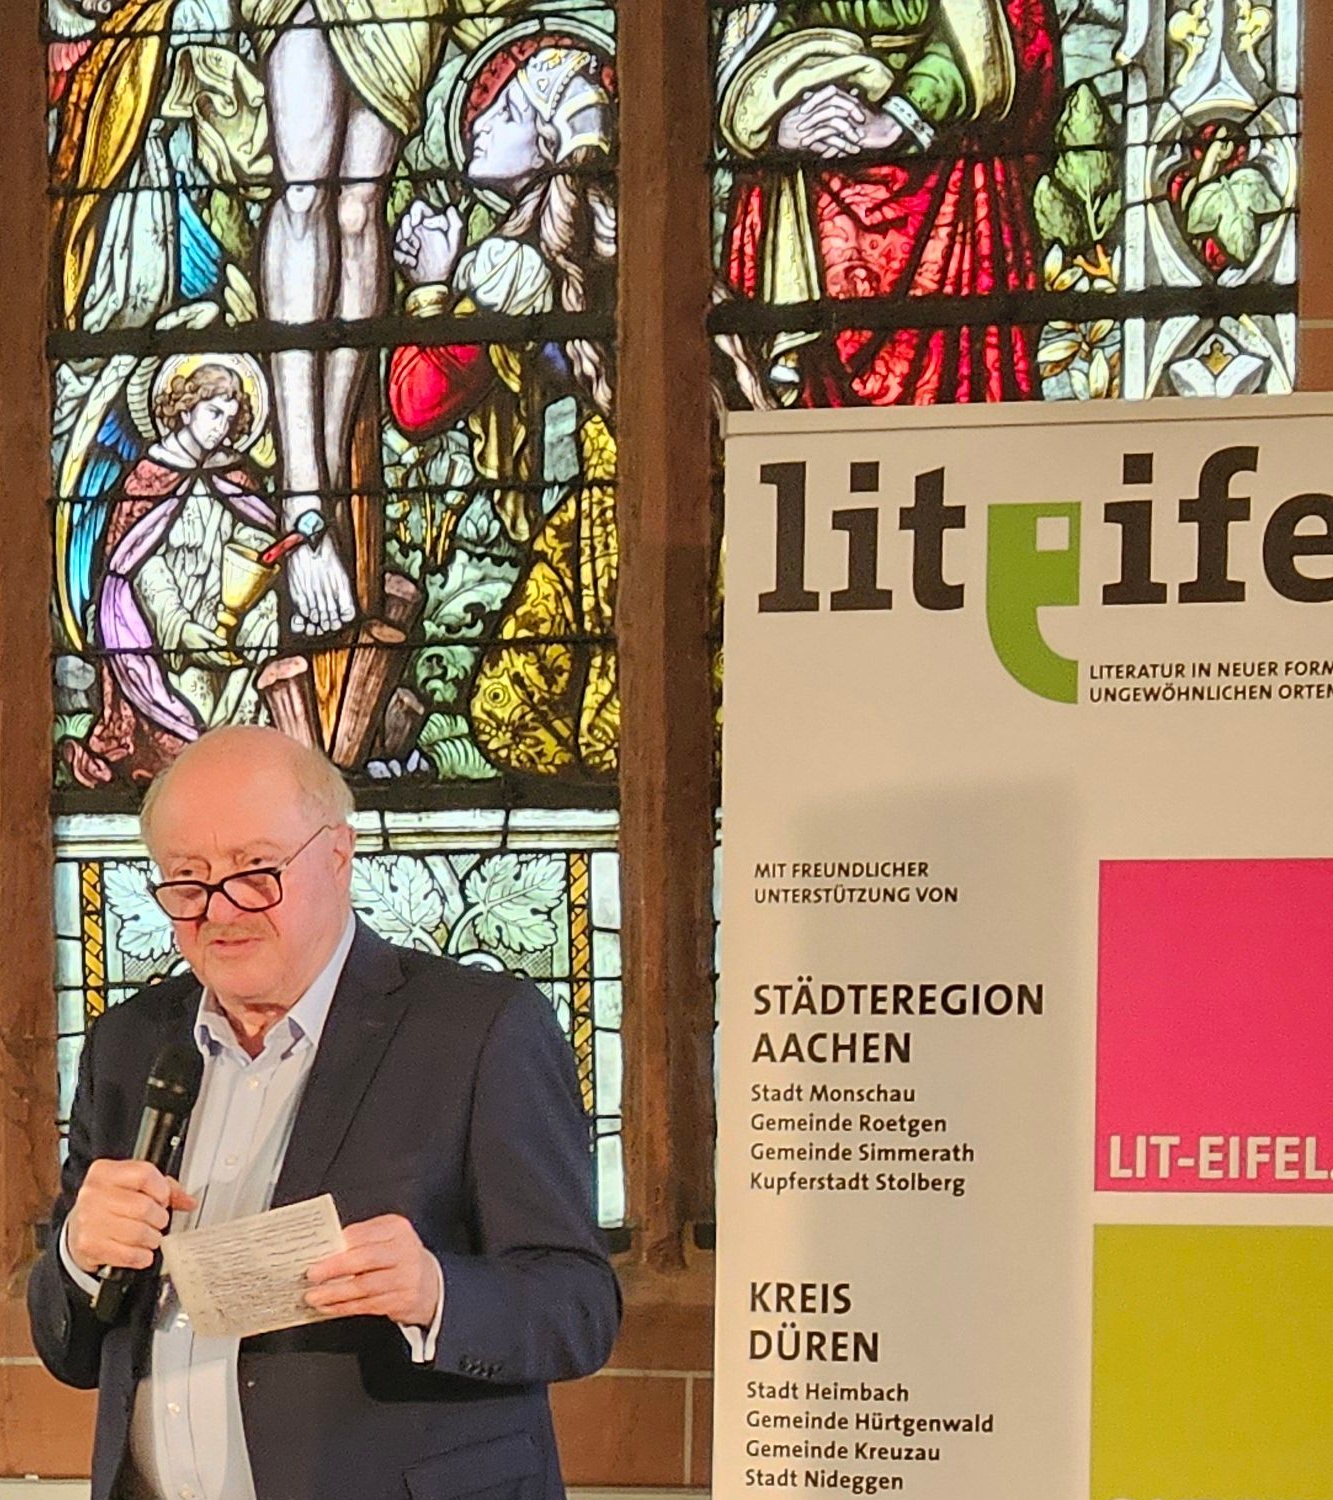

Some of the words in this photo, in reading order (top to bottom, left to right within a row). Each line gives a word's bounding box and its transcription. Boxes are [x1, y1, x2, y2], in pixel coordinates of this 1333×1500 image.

[1089, 663, 1185, 680] LITERATUR
[1191, 662, 1211, 678] IN
[1217, 661, 1279, 678] NEUER
[1089, 682, 1272, 704] UNGEWÖHNLICHEN
[755, 863, 786, 878] MIT
[792, 862, 929, 877] FREUNDLICHER
[754, 884, 910, 904] UNTERSTÜTZUNG
[916, 887, 958, 903] VON
[754, 975, 1044, 1015] STÄDTEREGION
[752, 1033, 911, 1063] AACHEN
[752, 1084, 803, 1102] Stadt
[810, 1085, 915, 1102] Monschau
[751, 1113, 853, 1132] Gemeinde
[860, 1114, 947, 1137] Roetgen
[751, 1143, 852, 1161] Gemeinde
[859, 1143, 974, 1162] Simmerath
[1109, 1135, 1333, 1180] LIT-EIFEL
[750, 1173, 869, 1195] Kupferstadt
[876, 1173, 965, 1196] Stolberg
[749, 1282, 852, 1315] KREIS
[749, 1321, 879, 1362] DÜREN
[747, 1381, 799, 1400] Stadt
[806, 1383, 909, 1402] Heimbach
[746, 1411, 849, 1430] Gemeinde
[856, 1412, 994, 1436] Hürtgenwald
[746, 1440, 848, 1459] Gemeinde
[855, 1442, 940, 1461] Kreuzau
[745, 1469, 798, 1487] Stadt
[804, 1470, 904, 1494] Nideggen
